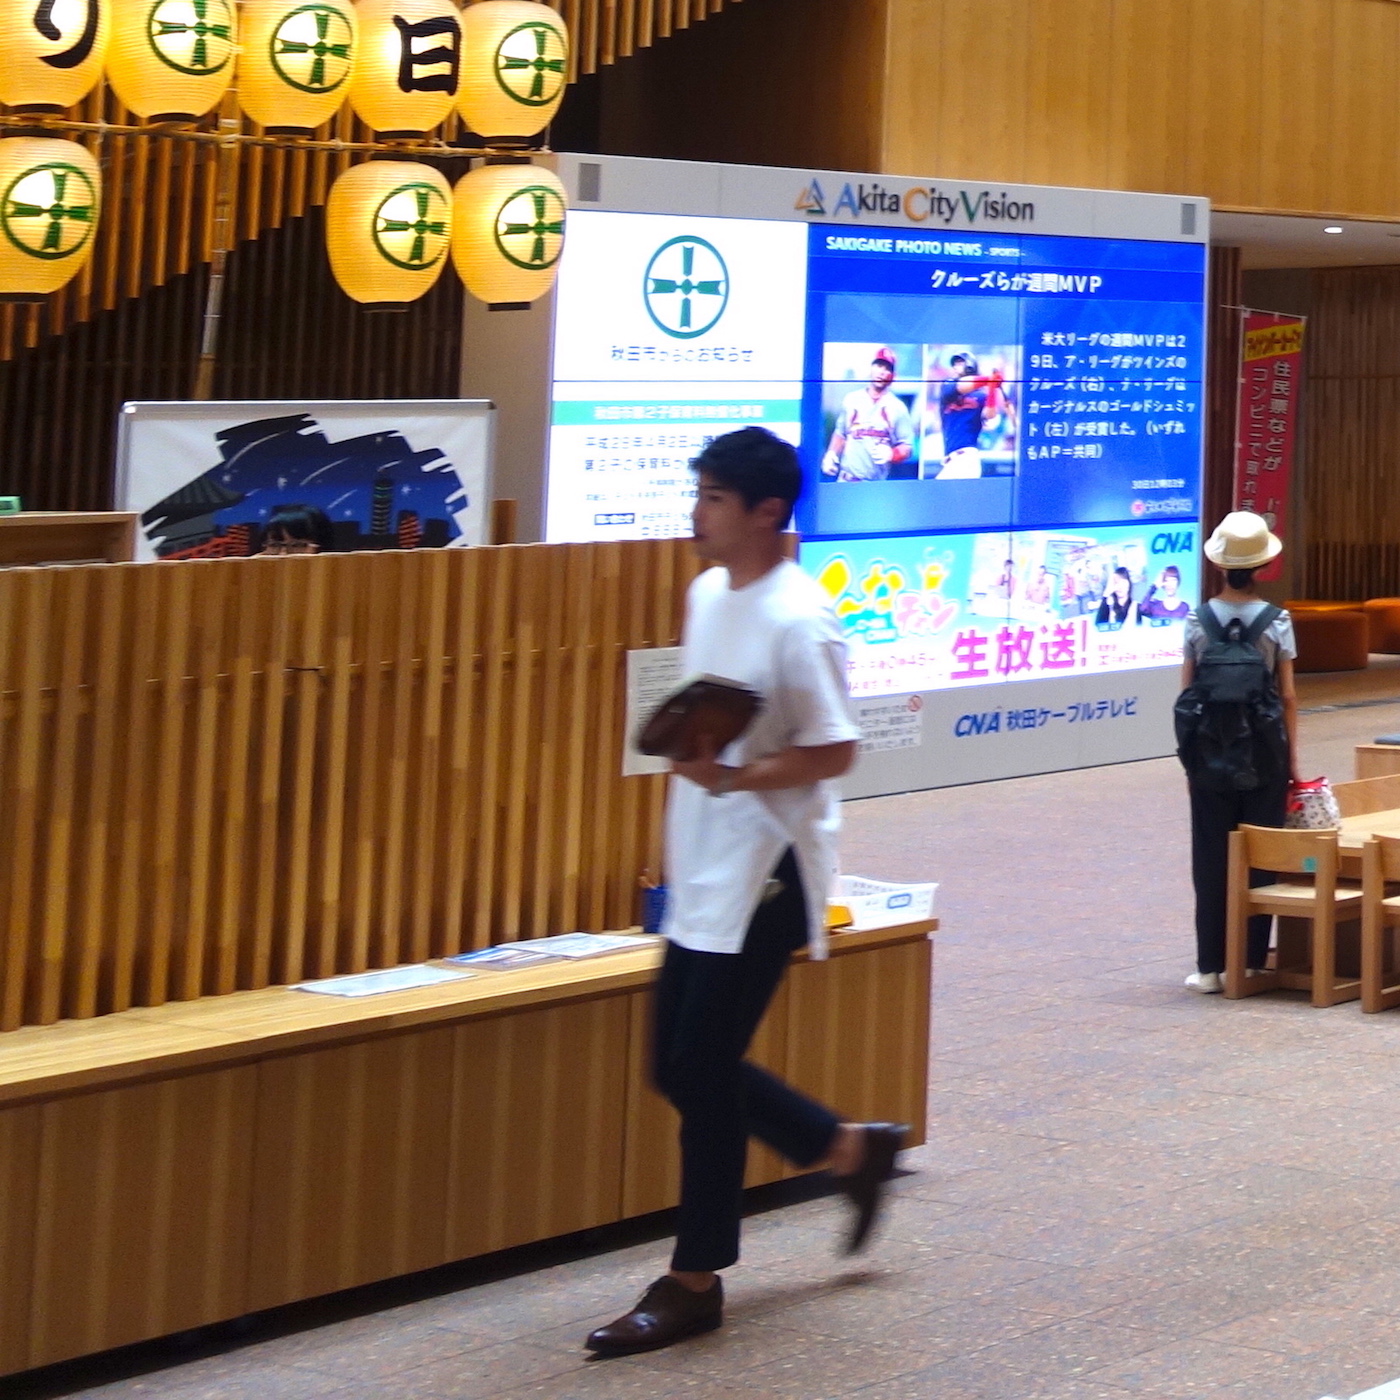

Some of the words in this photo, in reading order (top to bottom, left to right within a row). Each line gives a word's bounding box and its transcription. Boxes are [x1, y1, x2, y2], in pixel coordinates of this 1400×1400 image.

[833, 182, 899, 215] Akita
[903, 187, 960, 222] City
[960, 191, 1034, 222] Vision
[895, 239, 942, 255] PHOTO
[943, 242, 982, 256] NEWS
[1152, 532, 1193, 554] CNA
[954, 711, 1001, 738] CNA
[1005, 698, 1137, 732] 秋田ケーブルテレビ
